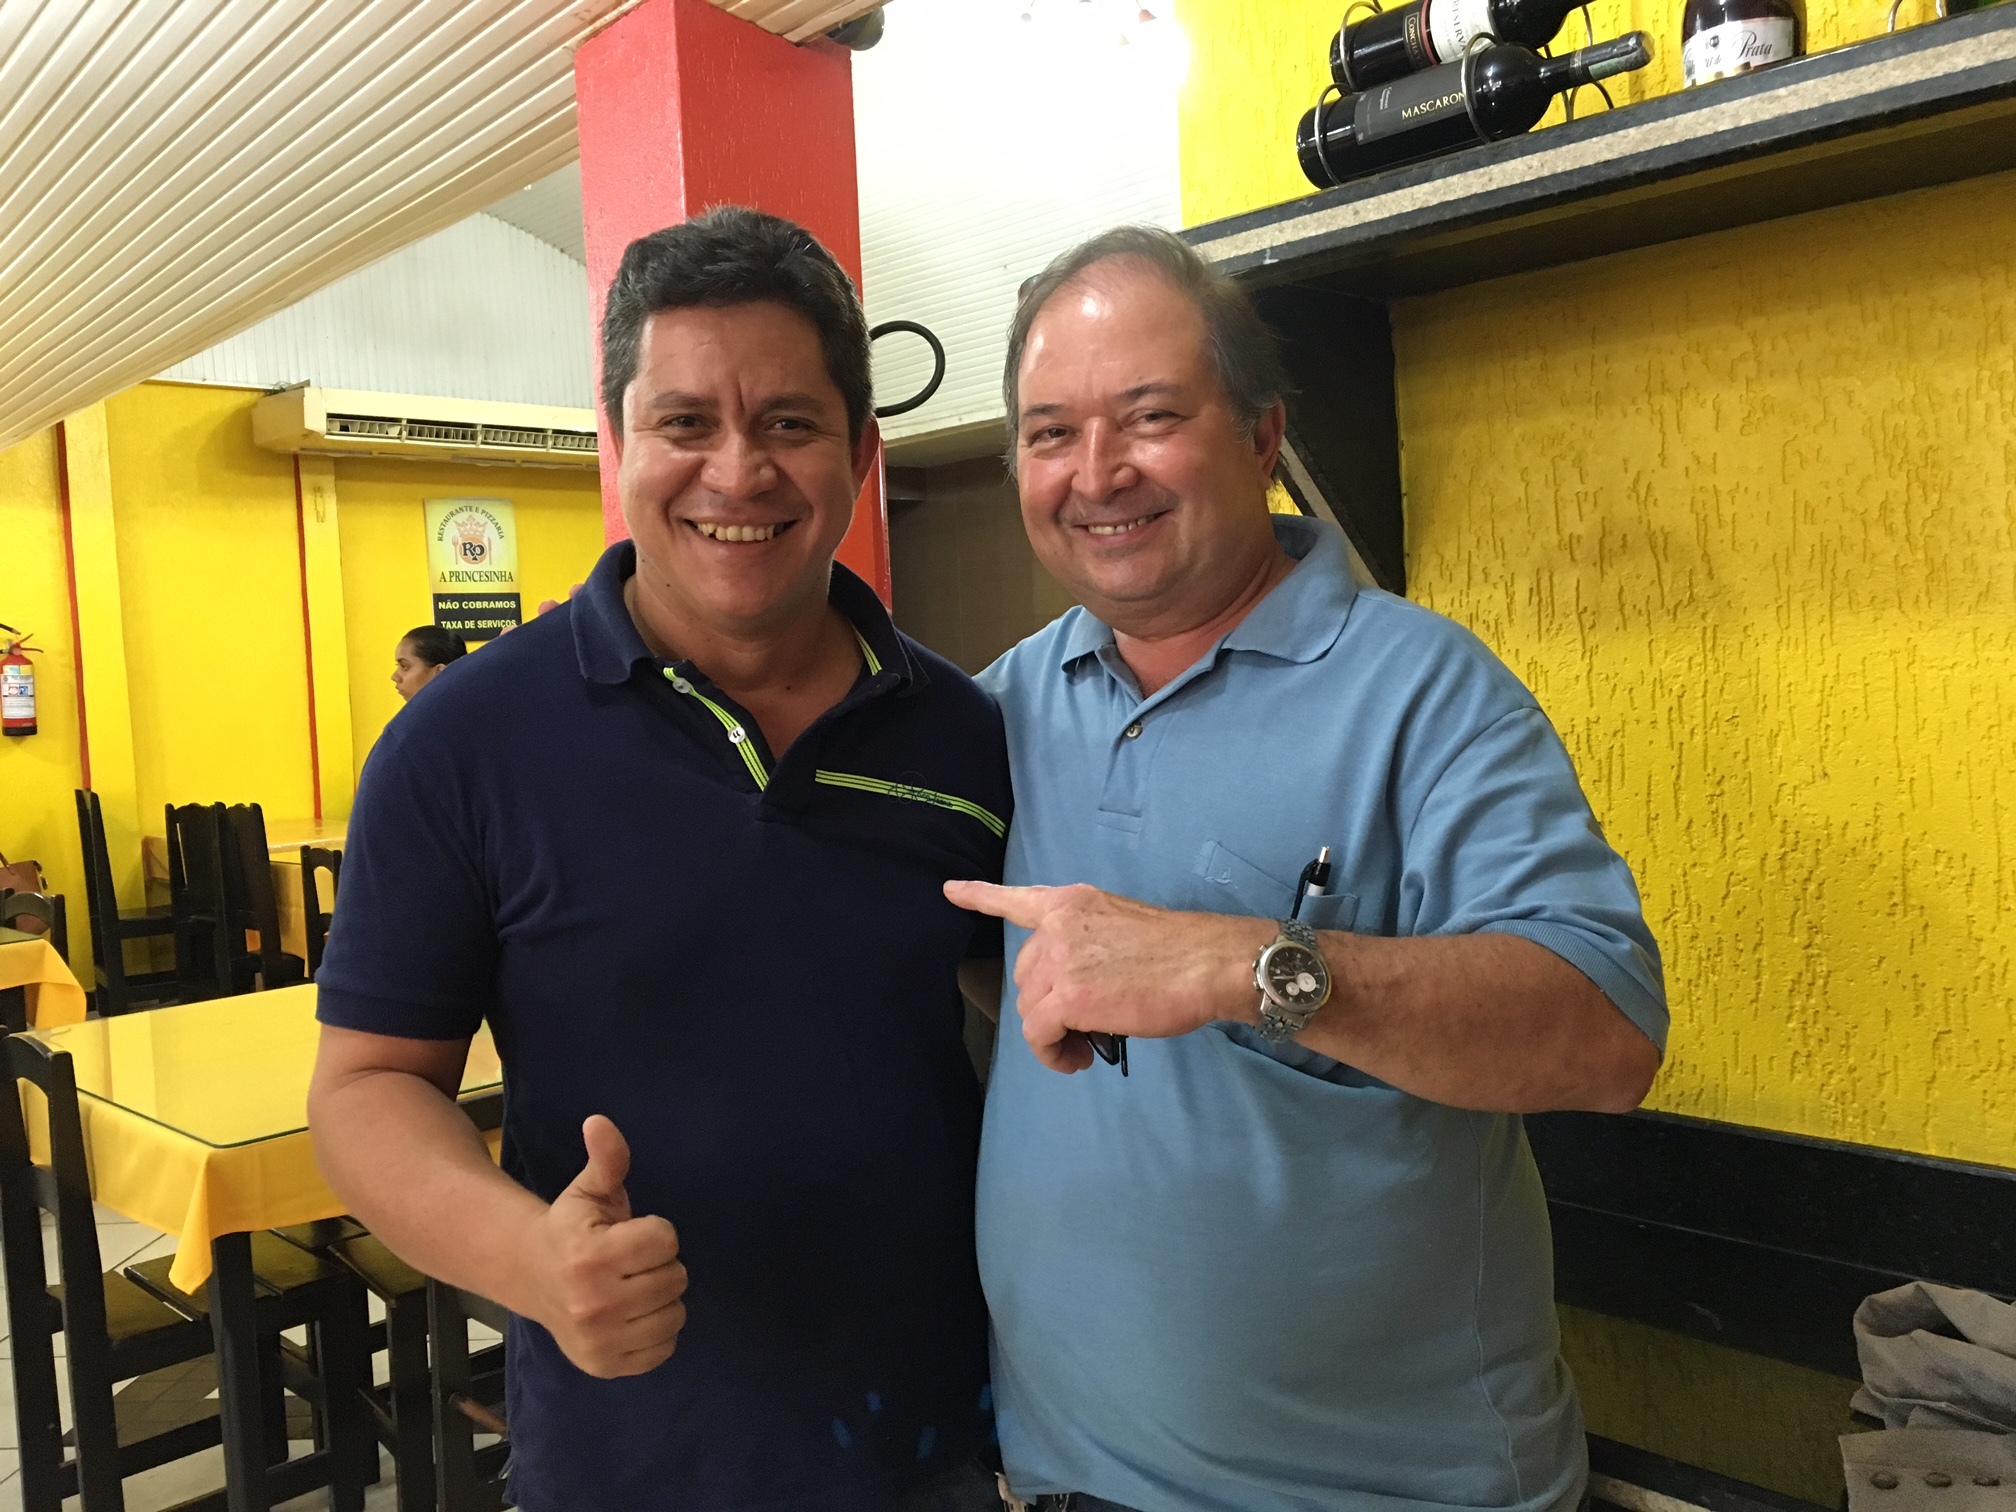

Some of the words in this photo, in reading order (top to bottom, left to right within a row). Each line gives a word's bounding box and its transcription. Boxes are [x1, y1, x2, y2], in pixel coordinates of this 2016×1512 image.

[1408, 17, 1419, 54] CONCHA
[1731, 30, 1773, 60] Prata
[1402, 92, 1465, 120] MASCARON
[437, 505, 474, 541] RESTAURANTE
[480, 509, 504, 540] PIZZARIA
[439, 571, 447, 583] A
[448, 570, 514, 583] PRINCESINHA
[438, 599, 460, 610] NÃO
[461, 600, 516, 609] COBRAMOS
[441, 620, 463, 630] TAXA
[464, 620, 475, 629] DE
